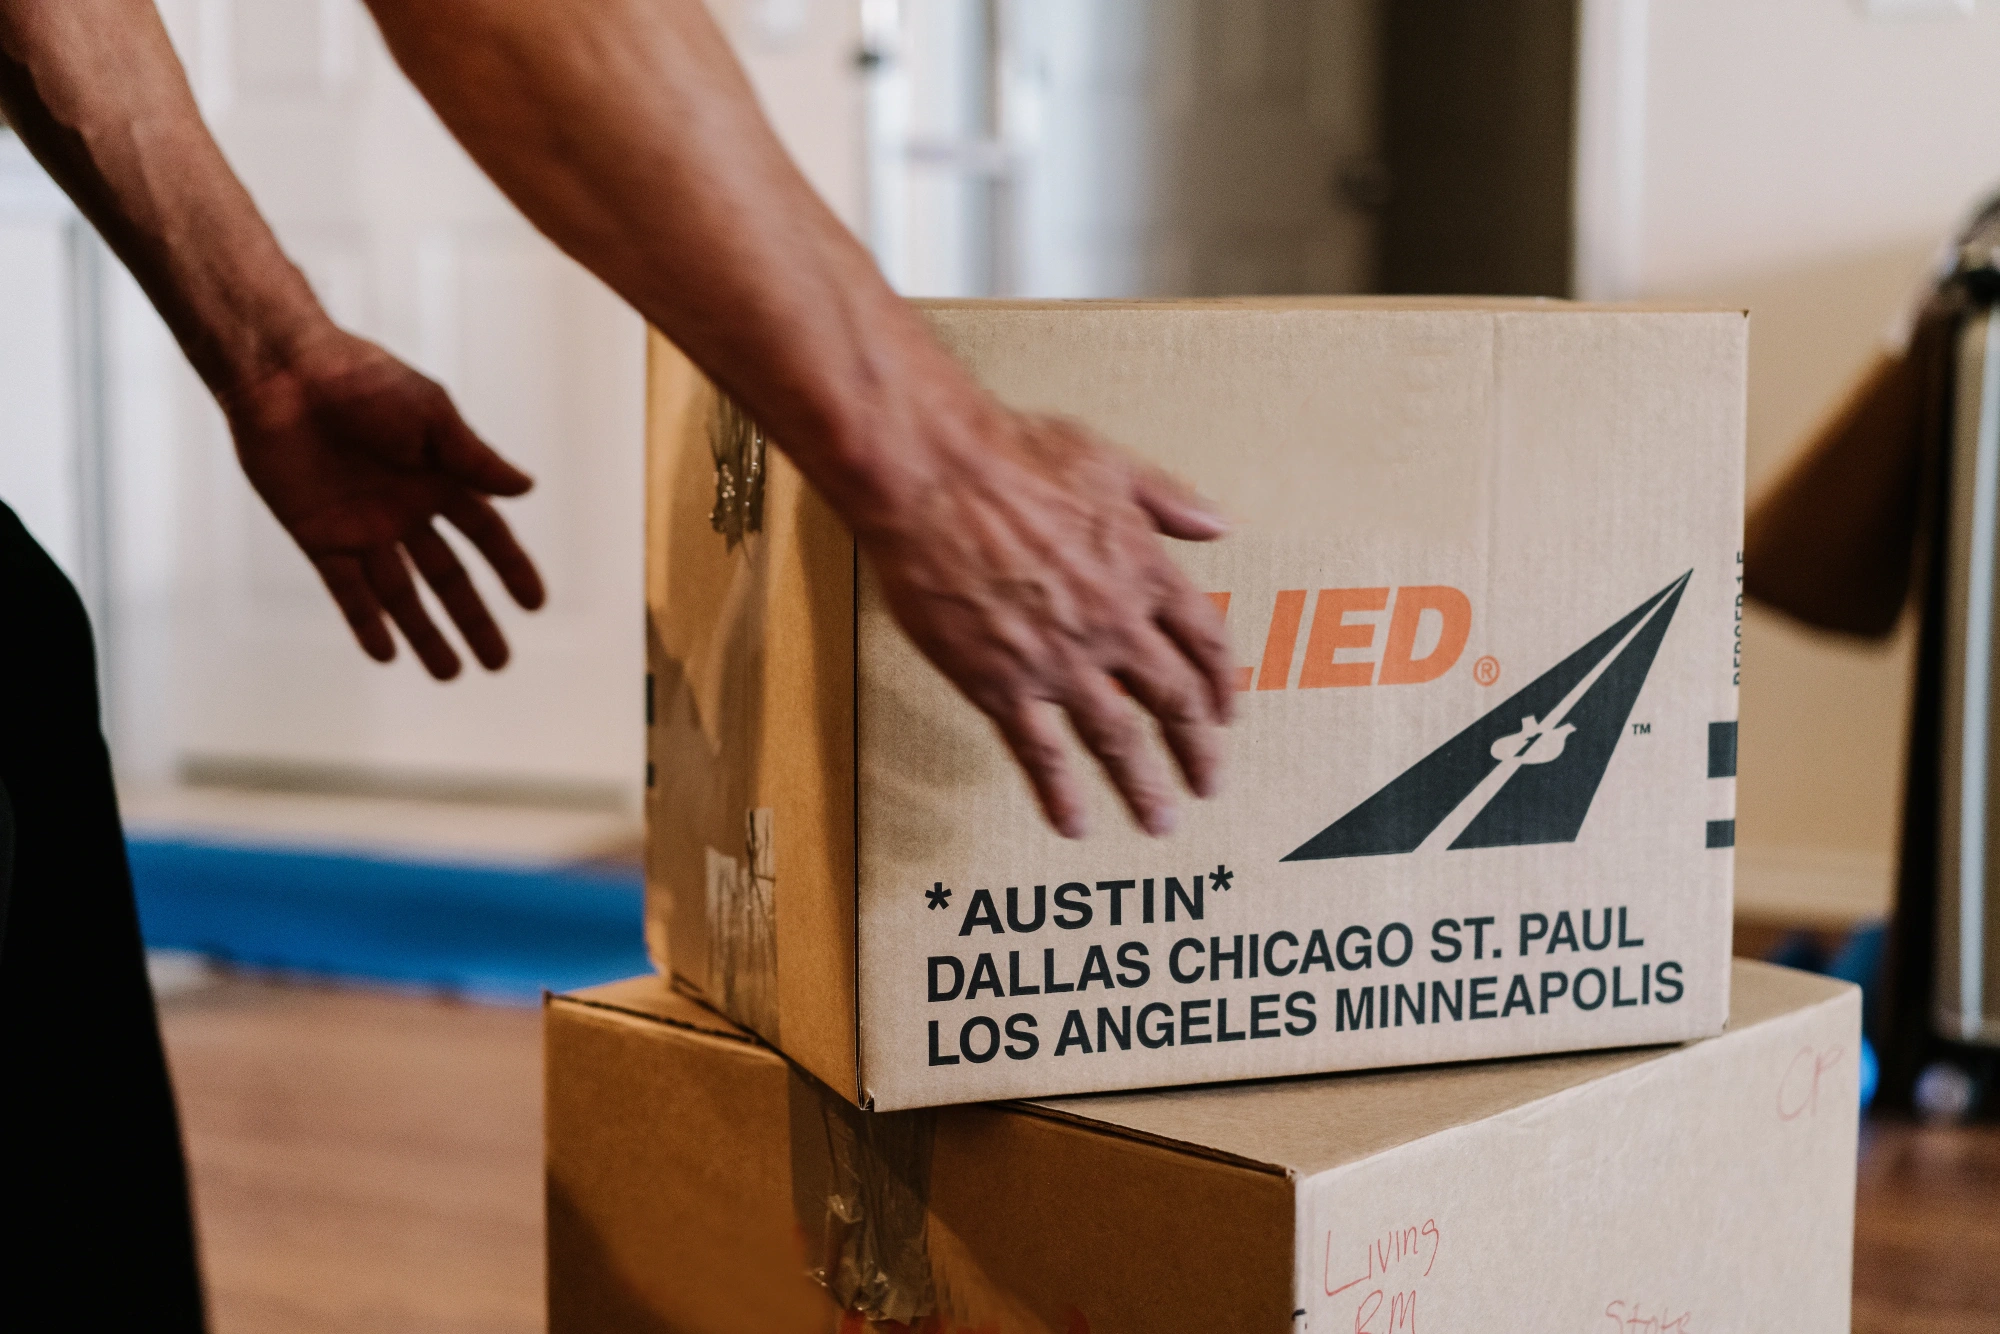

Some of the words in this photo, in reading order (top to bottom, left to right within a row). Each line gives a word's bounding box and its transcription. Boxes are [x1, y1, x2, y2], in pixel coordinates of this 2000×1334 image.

[1631, 723, 1652, 735] TM
[926, 941, 1151, 1003] DALLAS
[1168, 922, 1414, 985] CHICAGO
[1430, 916, 1502, 964] ST.
[1519, 906, 1644, 957] PAUL
[927, 1012, 1040, 1067] LOS
[1053, 990, 1317, 1057] ANGELES
[1335, 961, 1684, 1033] MINNEAPOLIS
[1324, 1218, 1440, 1297] Living
